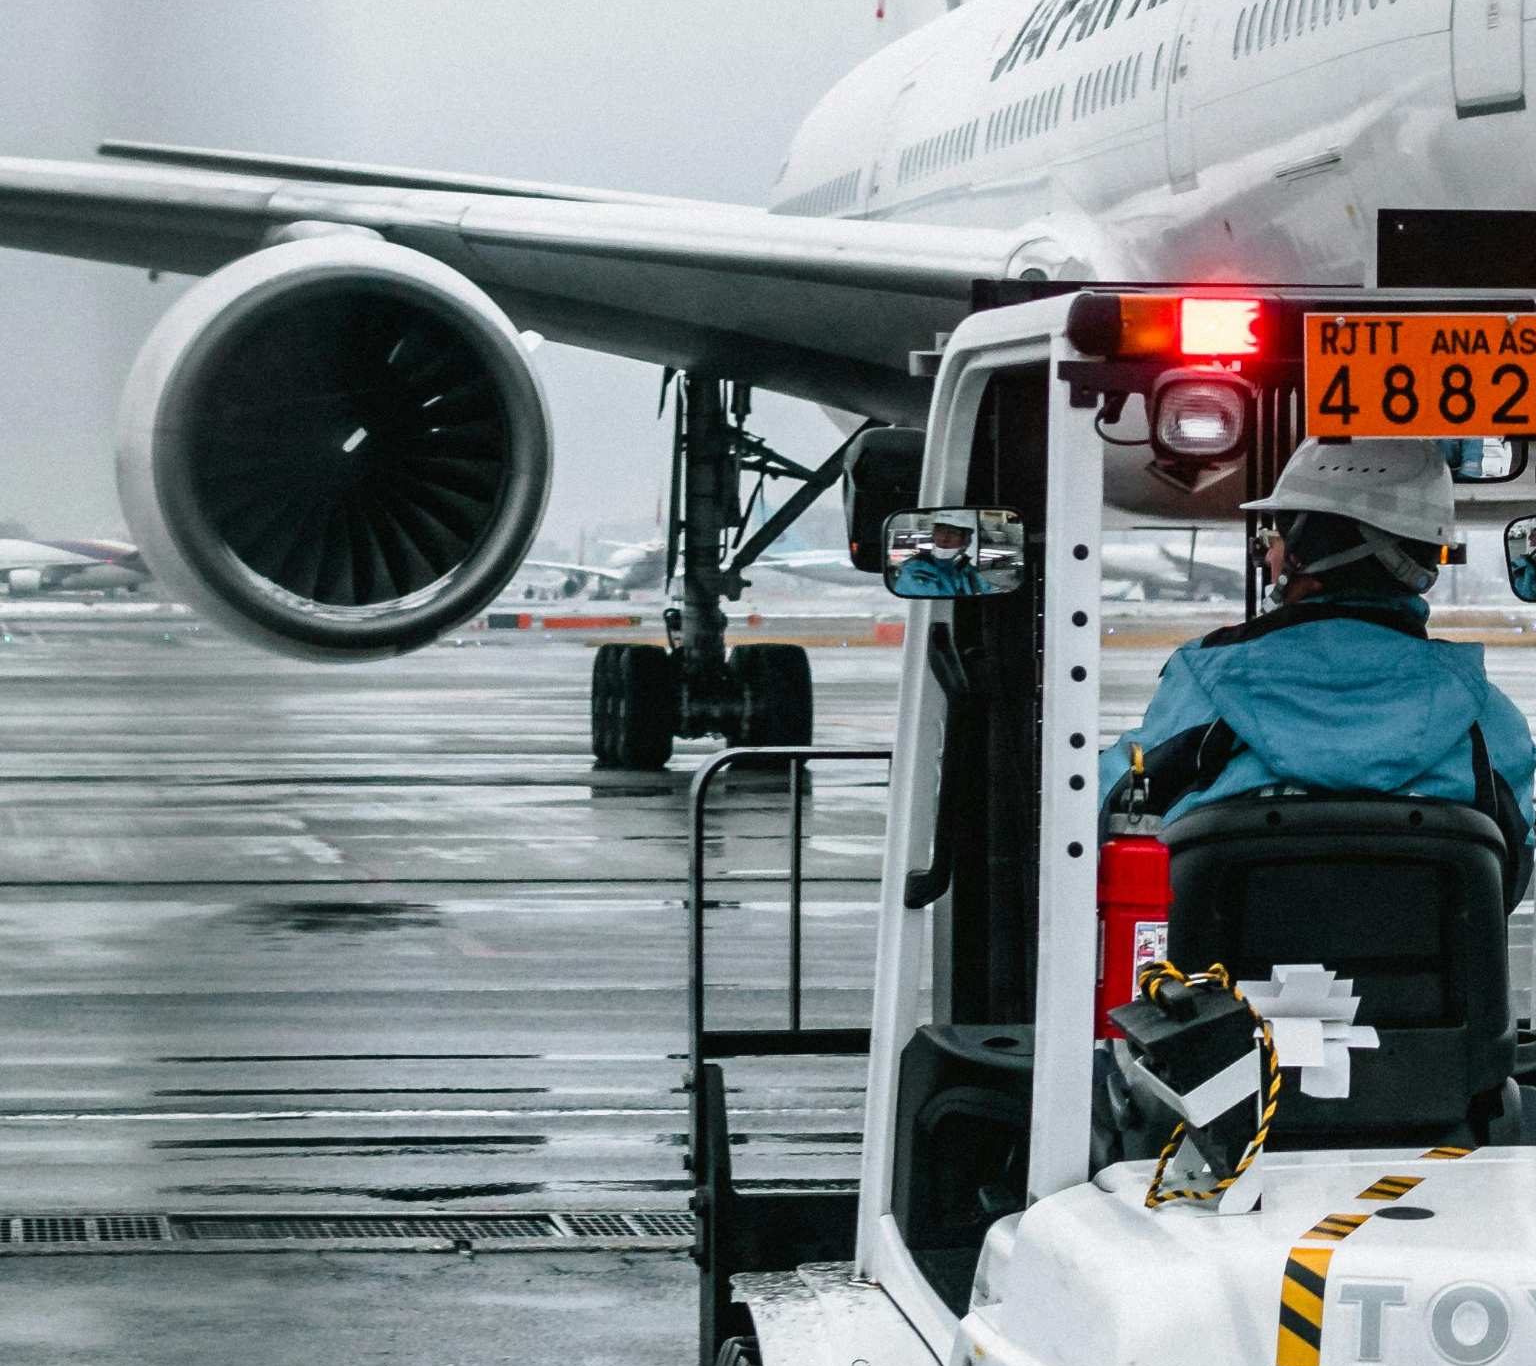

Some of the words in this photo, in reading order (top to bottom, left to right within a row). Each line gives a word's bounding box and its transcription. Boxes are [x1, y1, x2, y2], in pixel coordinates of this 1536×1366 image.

[1320, 321, 1404, 356] RJTT
[1431, 329, 1490, 355] ANA
[1319, 364, 1529, 425] 4882
